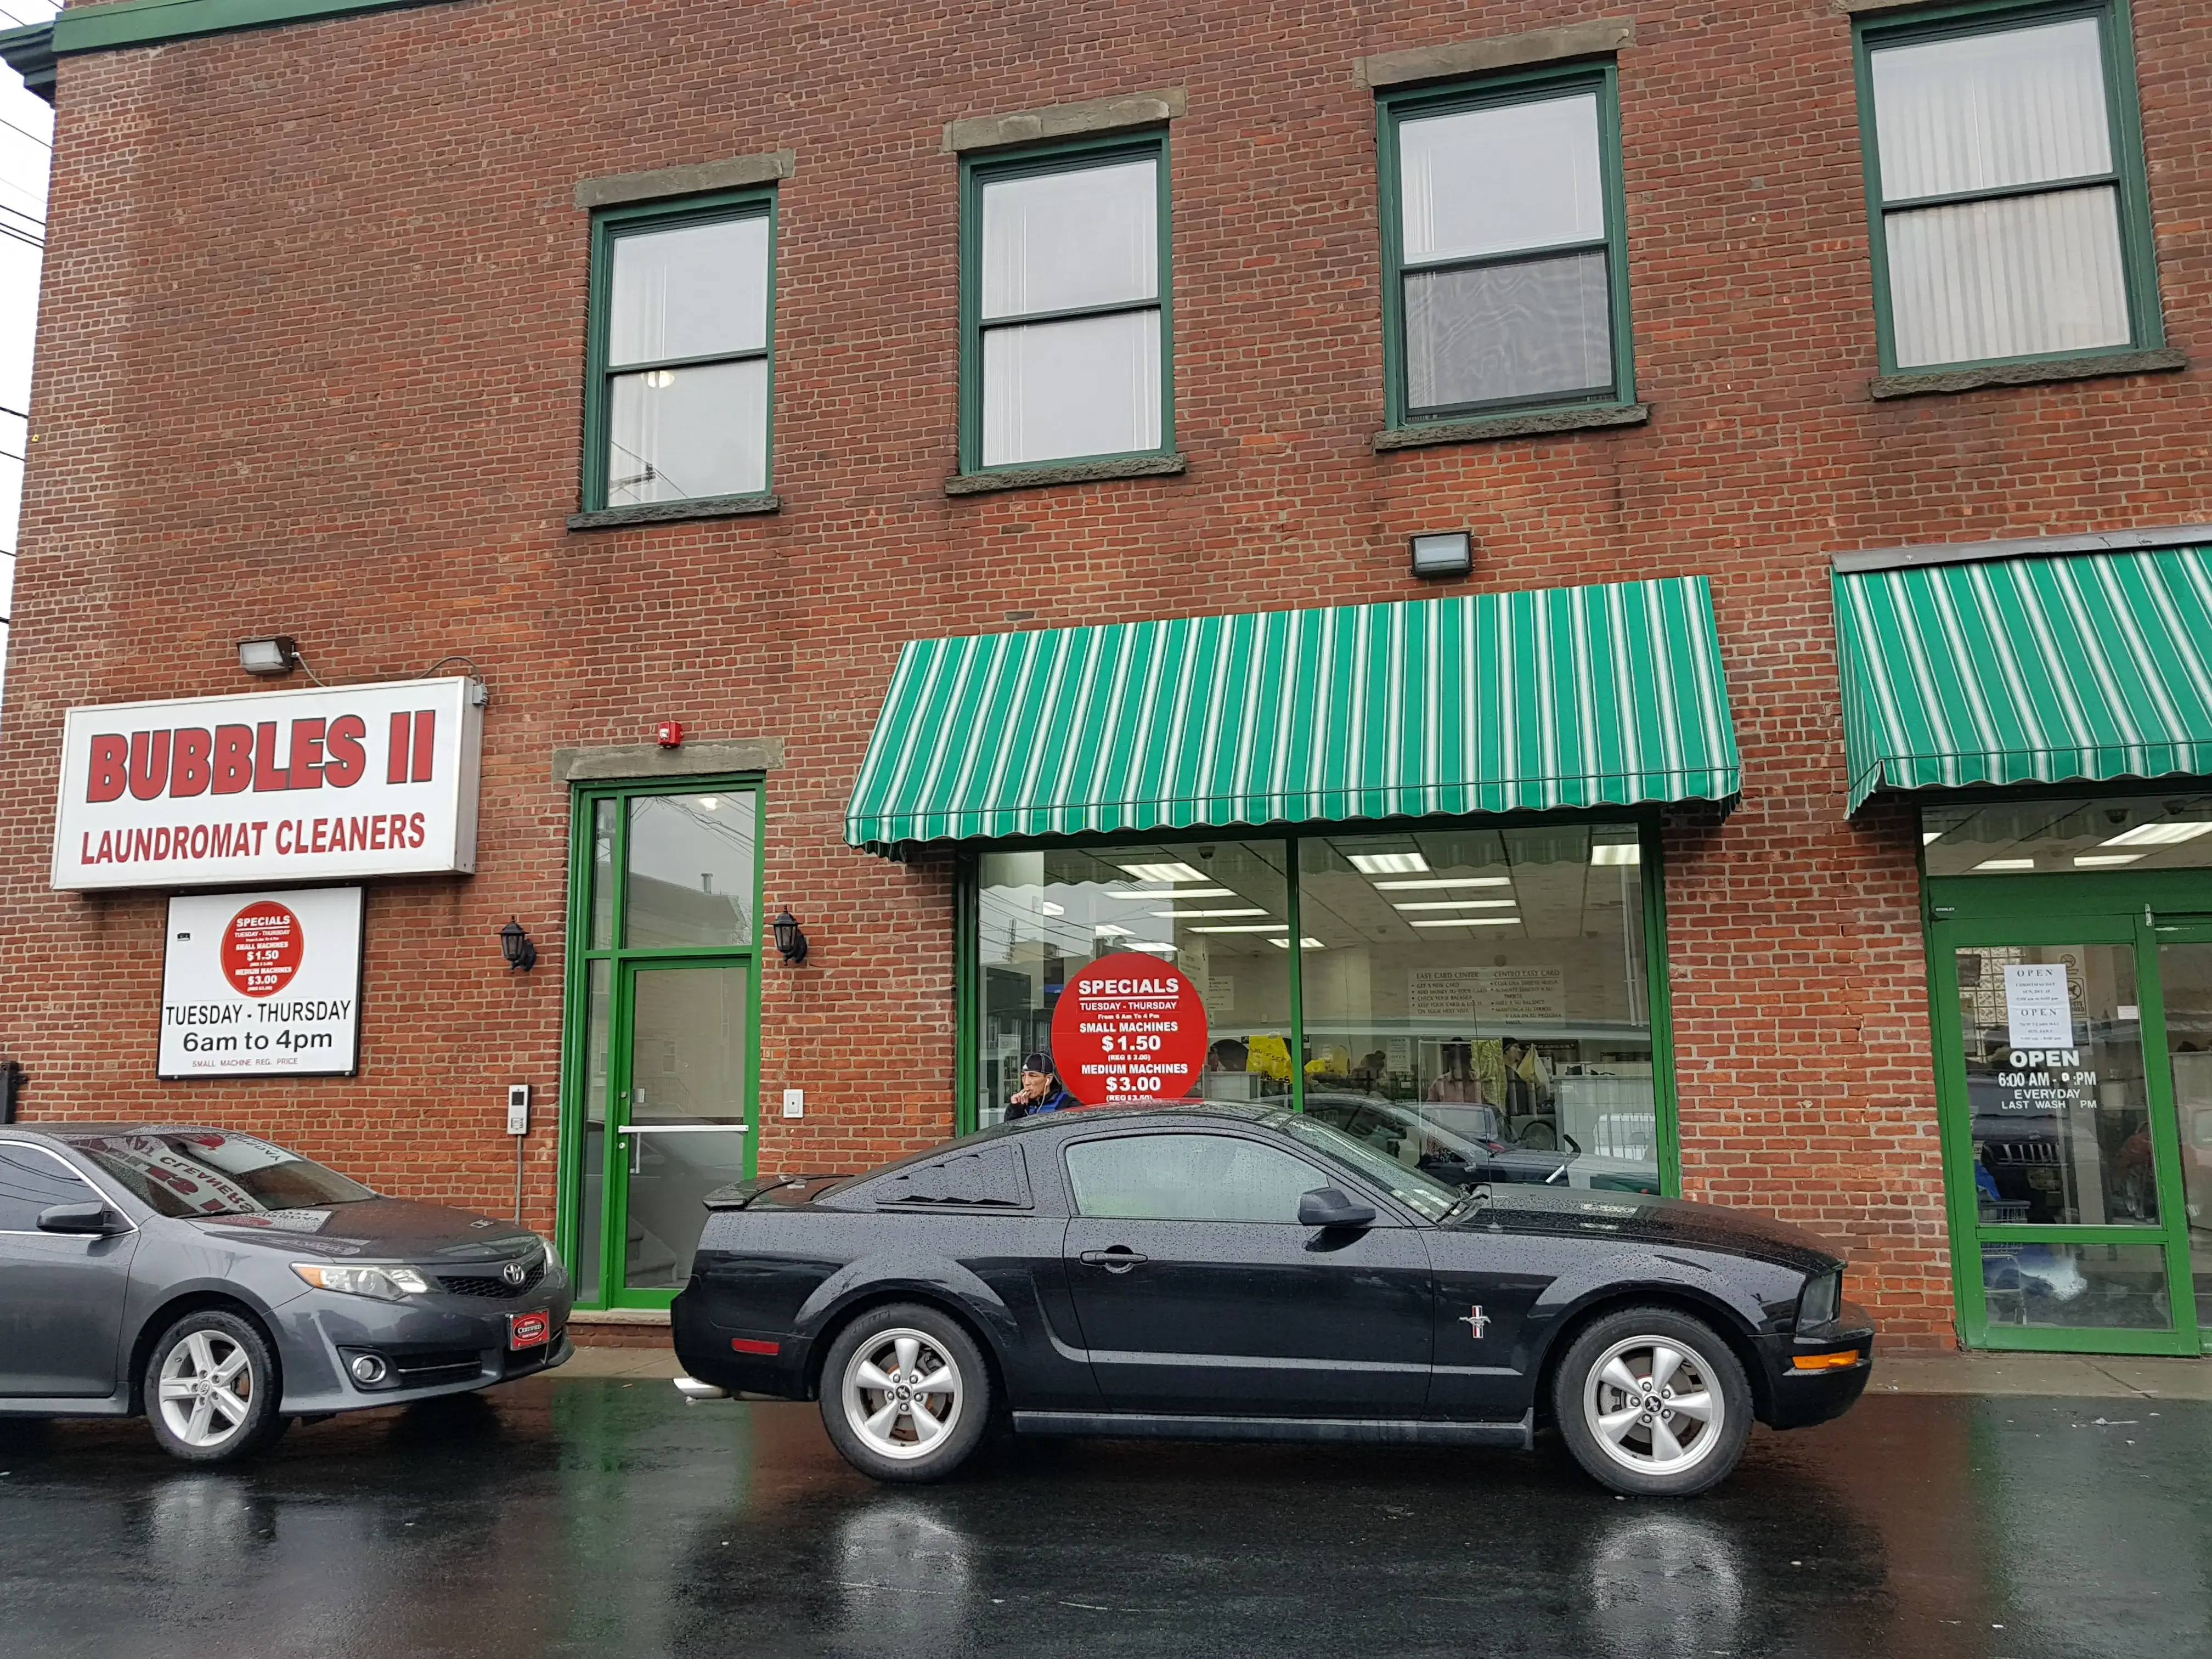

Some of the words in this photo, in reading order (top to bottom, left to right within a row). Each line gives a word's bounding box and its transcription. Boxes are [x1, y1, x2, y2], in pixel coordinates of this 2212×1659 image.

[86, 714, 366, 804] BUBBLES
[386, 709, 436, 785] II
[81, 821, 268, 865] LAUNDROMAT
[275, 812, 425, 855] CLEANERS
[236, 915, 290, 927] SPECIALS
[2017, 969, 2053, 977] OPEN
[1079, 978, 1179, 995] SPECIALS
[166, 1004, 243, 1025] TUESDAY
[257, 1000, 351, 1023] THURSDAY
[1080, 1002, 1121, 1011] TUESDAY
[1128, 1002, 1177, 1010] THURSDAY
[1079, 1023, 1116, 1032] SMALL
[1119, 1022, 1178, 1032] MACHINES
[183, 1032, 238, 1052] 6am
[245, 1032, 269, 1050] to
[276, 1029, 333, 1053] 4pm
[2010, 1050, 2080, 1068] OPEN
[1081, 1064, 1126, 1075] MEDIUM
[1129, 1063, 1188, 1074] MACHINES
[1106, 1076, 1161, 1092] $3.00
[1998, 1072, 2025, 1087] 6:00
[2029, 1072, 2050, 1087] AM
[2014, 1088, 2081, 1100] EVERYDAY
[2001, 1101, 2029, 1109] LAST
[2035, 1100, 2066, 1109] WASH
[2080, 1100, 2097, 1108] PM
